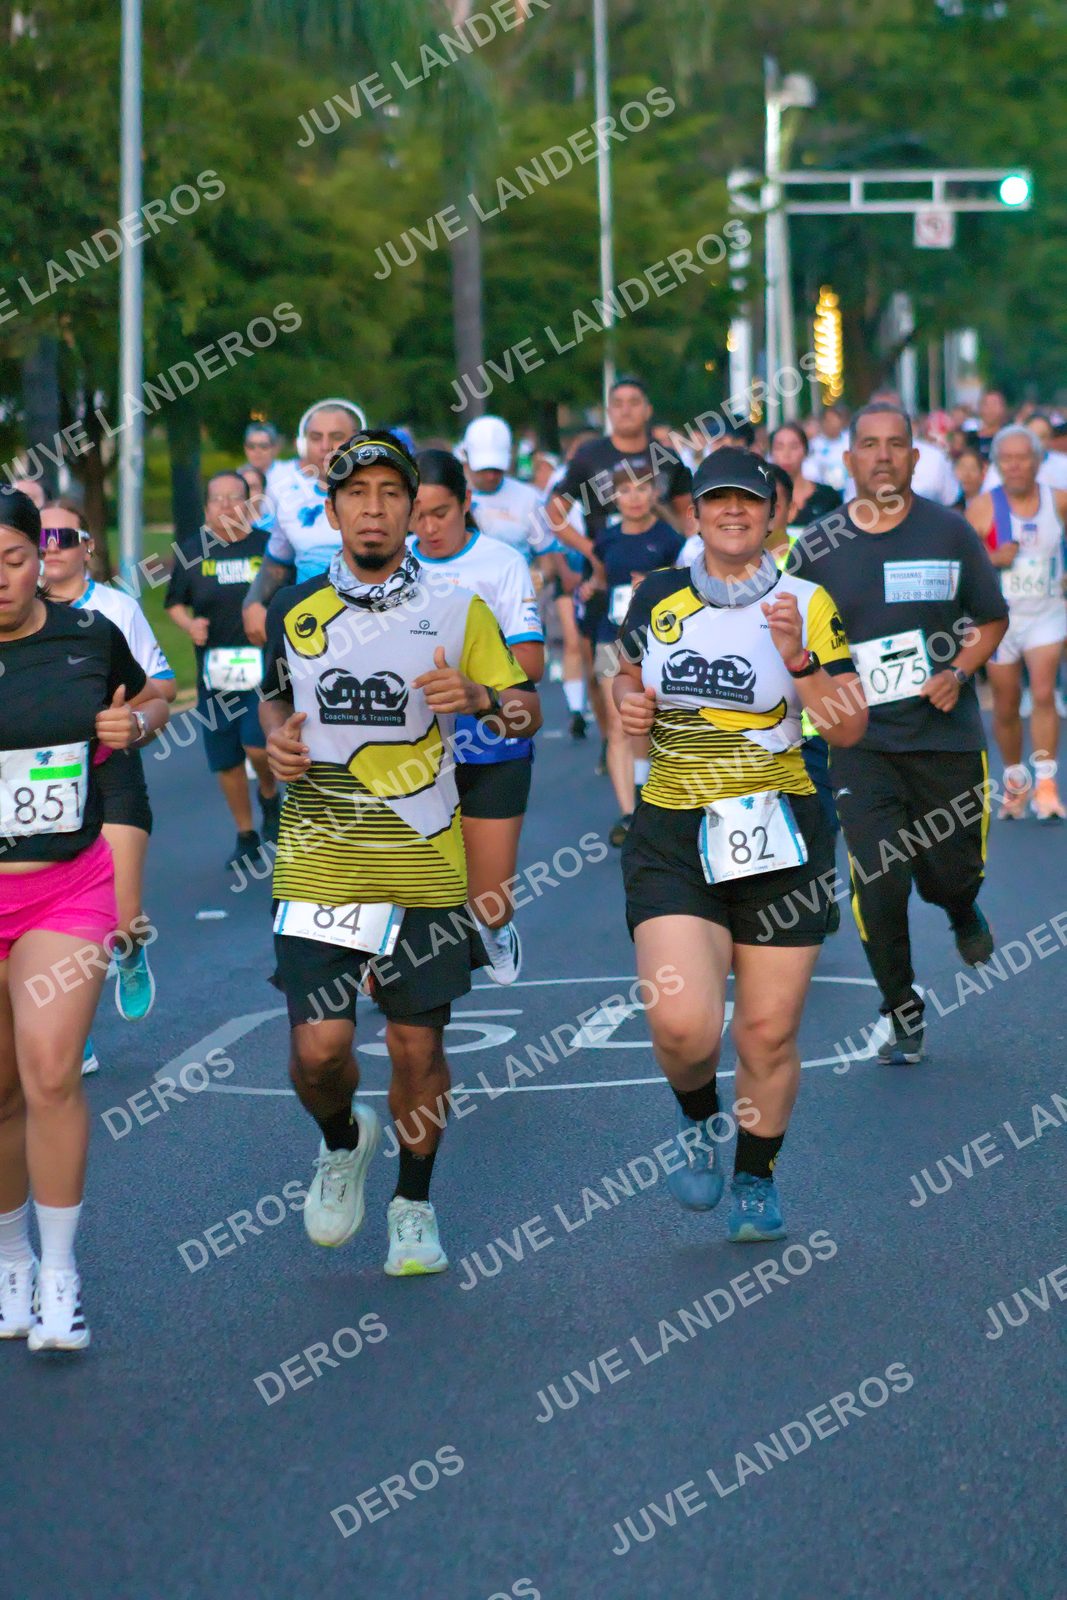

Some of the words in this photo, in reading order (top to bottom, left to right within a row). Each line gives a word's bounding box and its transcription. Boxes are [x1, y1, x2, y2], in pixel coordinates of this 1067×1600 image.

[410, 629, 438, 637] TOPTIME
[688, 667, 734, 677] RINOS
[870, 657, 927, 694] 075
[341, 688, 387, 699] RINOS
[666, 684, 703, 694] Coaching
[715, 689, 749, 700] Training
[324, 713, 359, 721] Coaching
[14, 782, 80, 824] 851
[729, 826, 775, 864] 82
[313, 903, 361, 935] 84
